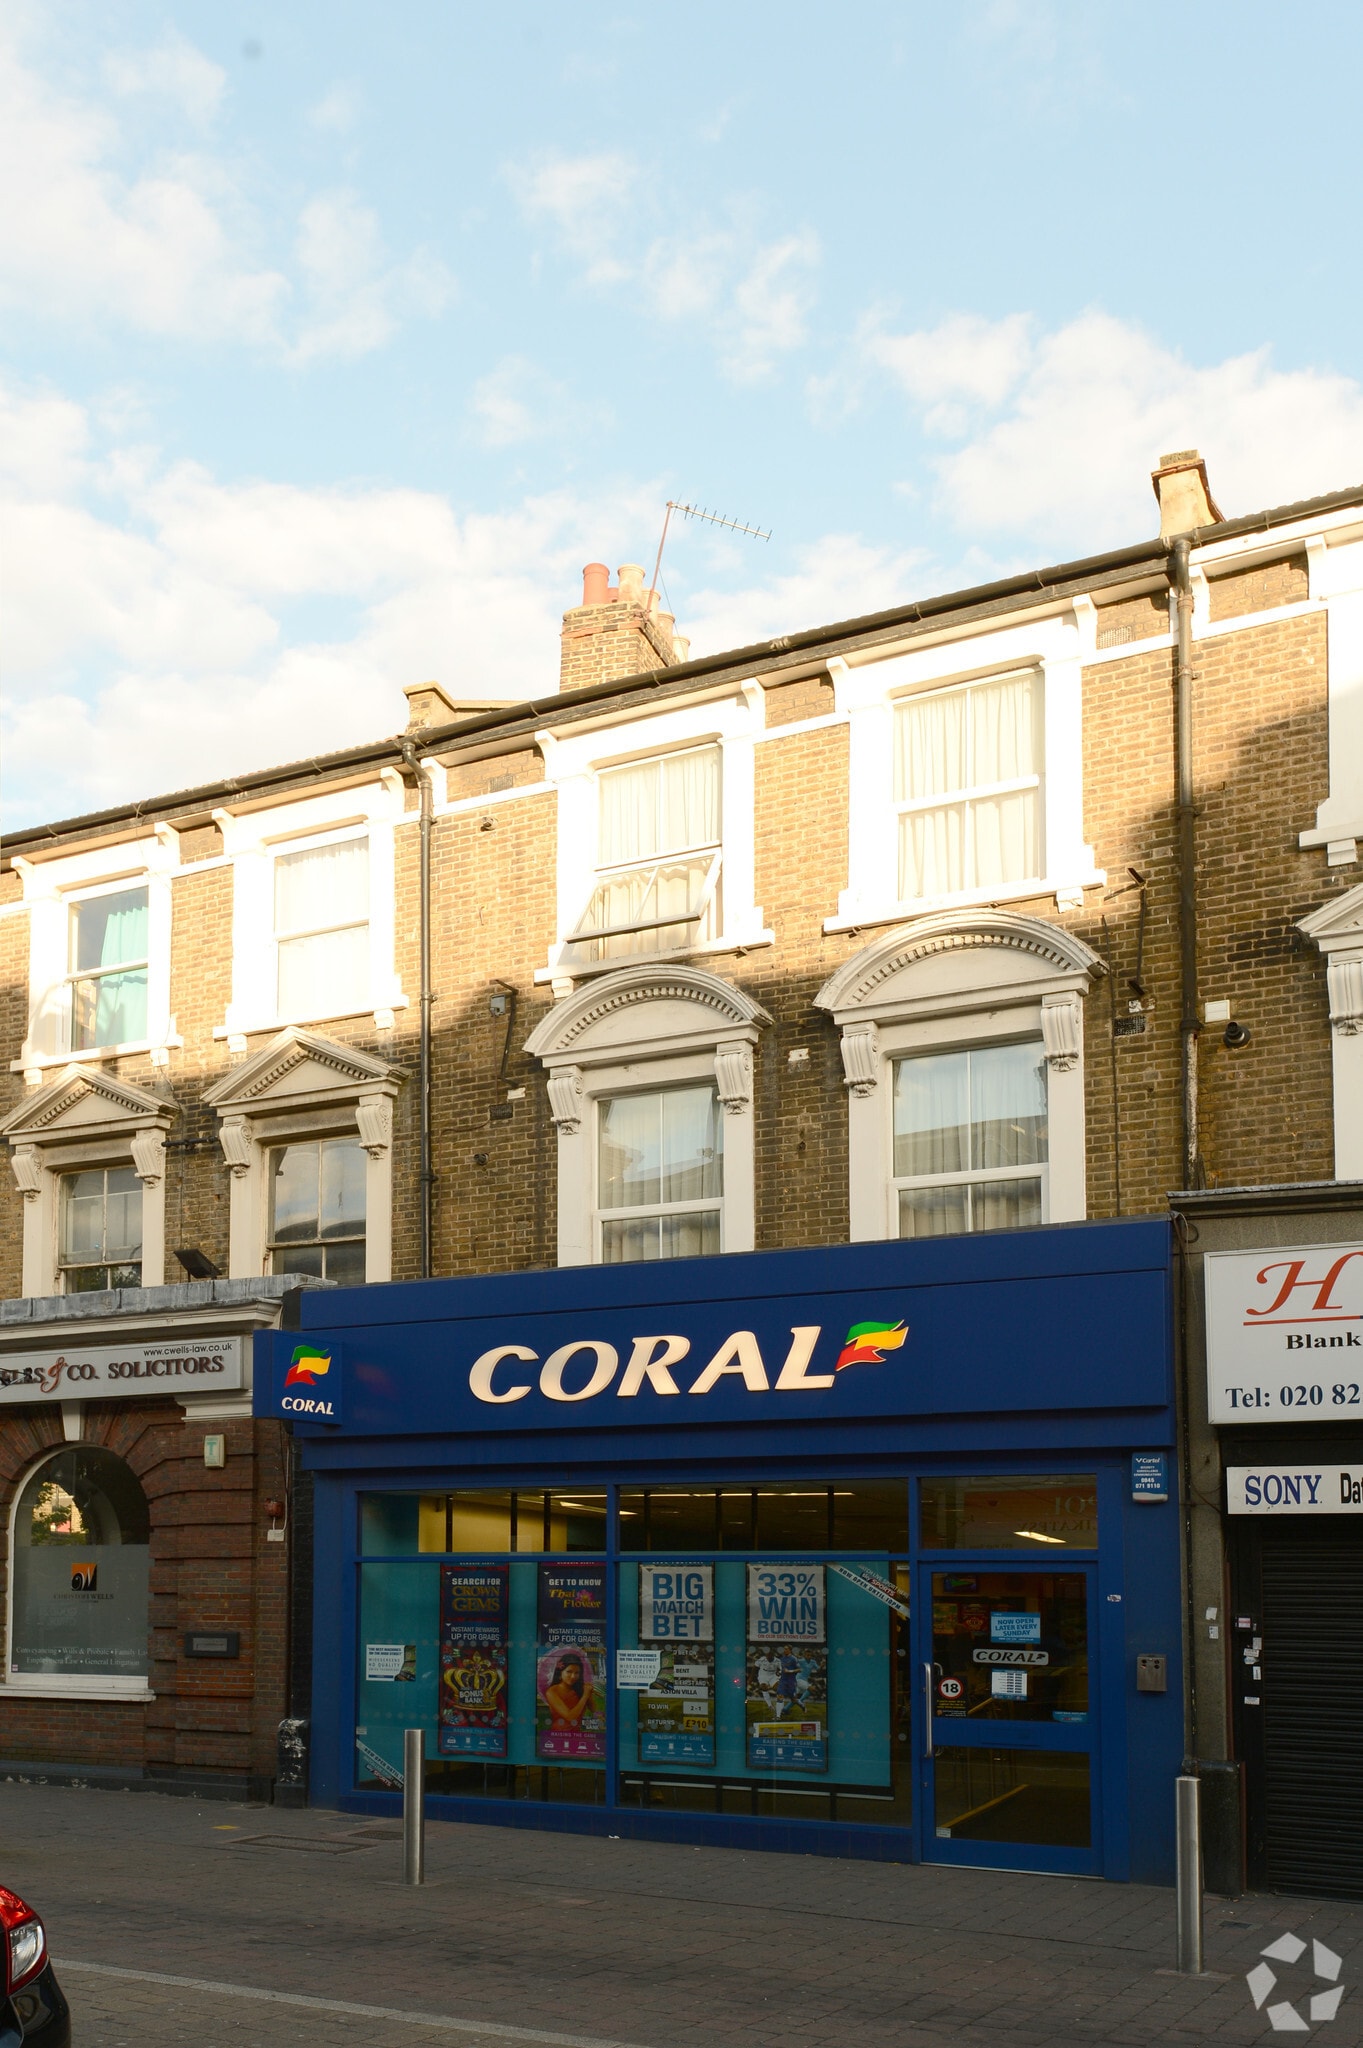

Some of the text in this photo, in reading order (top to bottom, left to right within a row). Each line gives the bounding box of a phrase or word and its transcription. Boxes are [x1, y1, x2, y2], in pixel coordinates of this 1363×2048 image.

[144, 1343, 232, 1357] www.cwells-law.co.uk
[108, 1355, 224, 1379] SOLICITORS
[468, 1326, 835, 1403] CORAL
[1225, 1383, 1361, 1408] Tel: 020 82
[281, 1396, 334, 1415] CORAL
[1245, 1474, 1322, 1506] SONY
[452, 1578, 501, 1586] SEARCH FOR
[452, 1585, 500, 1597] CROWN
[652, 1573, 704, 1600] BIG
[758, 1573, 817, 1596] 33%
[838, 1567, 853, 1579] NOW
[852, 1576, 868, 1589] OPEN
[868, 1586, 885, 1599] UNTIL
[452, 1597, 501, 1612] GEMS
[652, 1600, 704, 1614] MATCH
[758, 1597, 817, 1620] WIN
[653, 1615, 704, 1637] BET
[758, 1620, 817, 1635] BONUS
[976, 1651, 1036, 1663] CORAL
[459, 1689, 484, 1699] BONUS
[943, 1683, 959, 1693] 18
